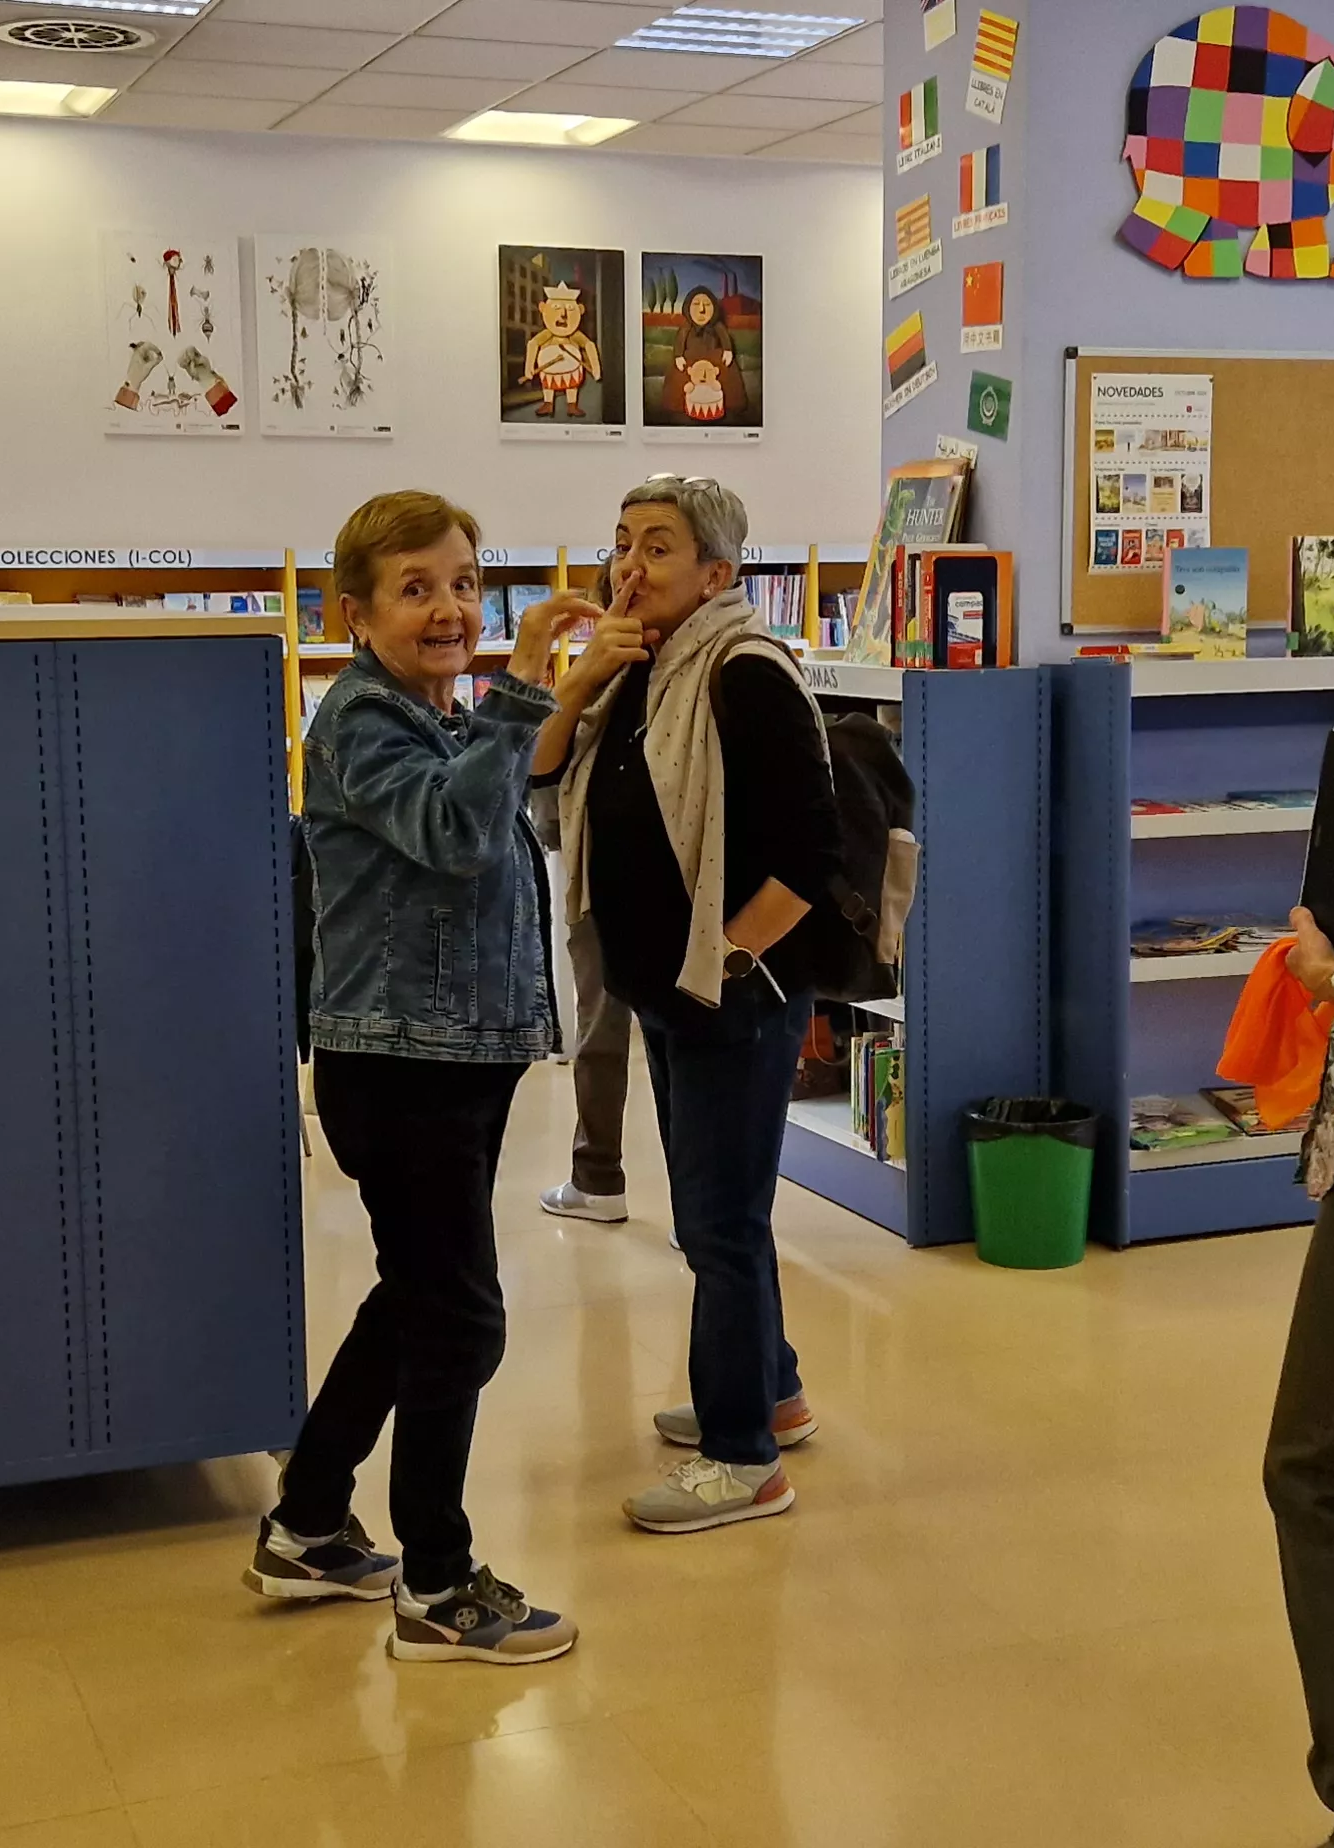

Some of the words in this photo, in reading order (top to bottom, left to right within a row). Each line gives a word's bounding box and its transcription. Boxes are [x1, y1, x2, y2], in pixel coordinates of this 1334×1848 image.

[1097, 386, 1164, 398] NOVEDADES
[906, 508, 945, 526] HUNTER
[129, 549, 192, 568] (I-COL)
